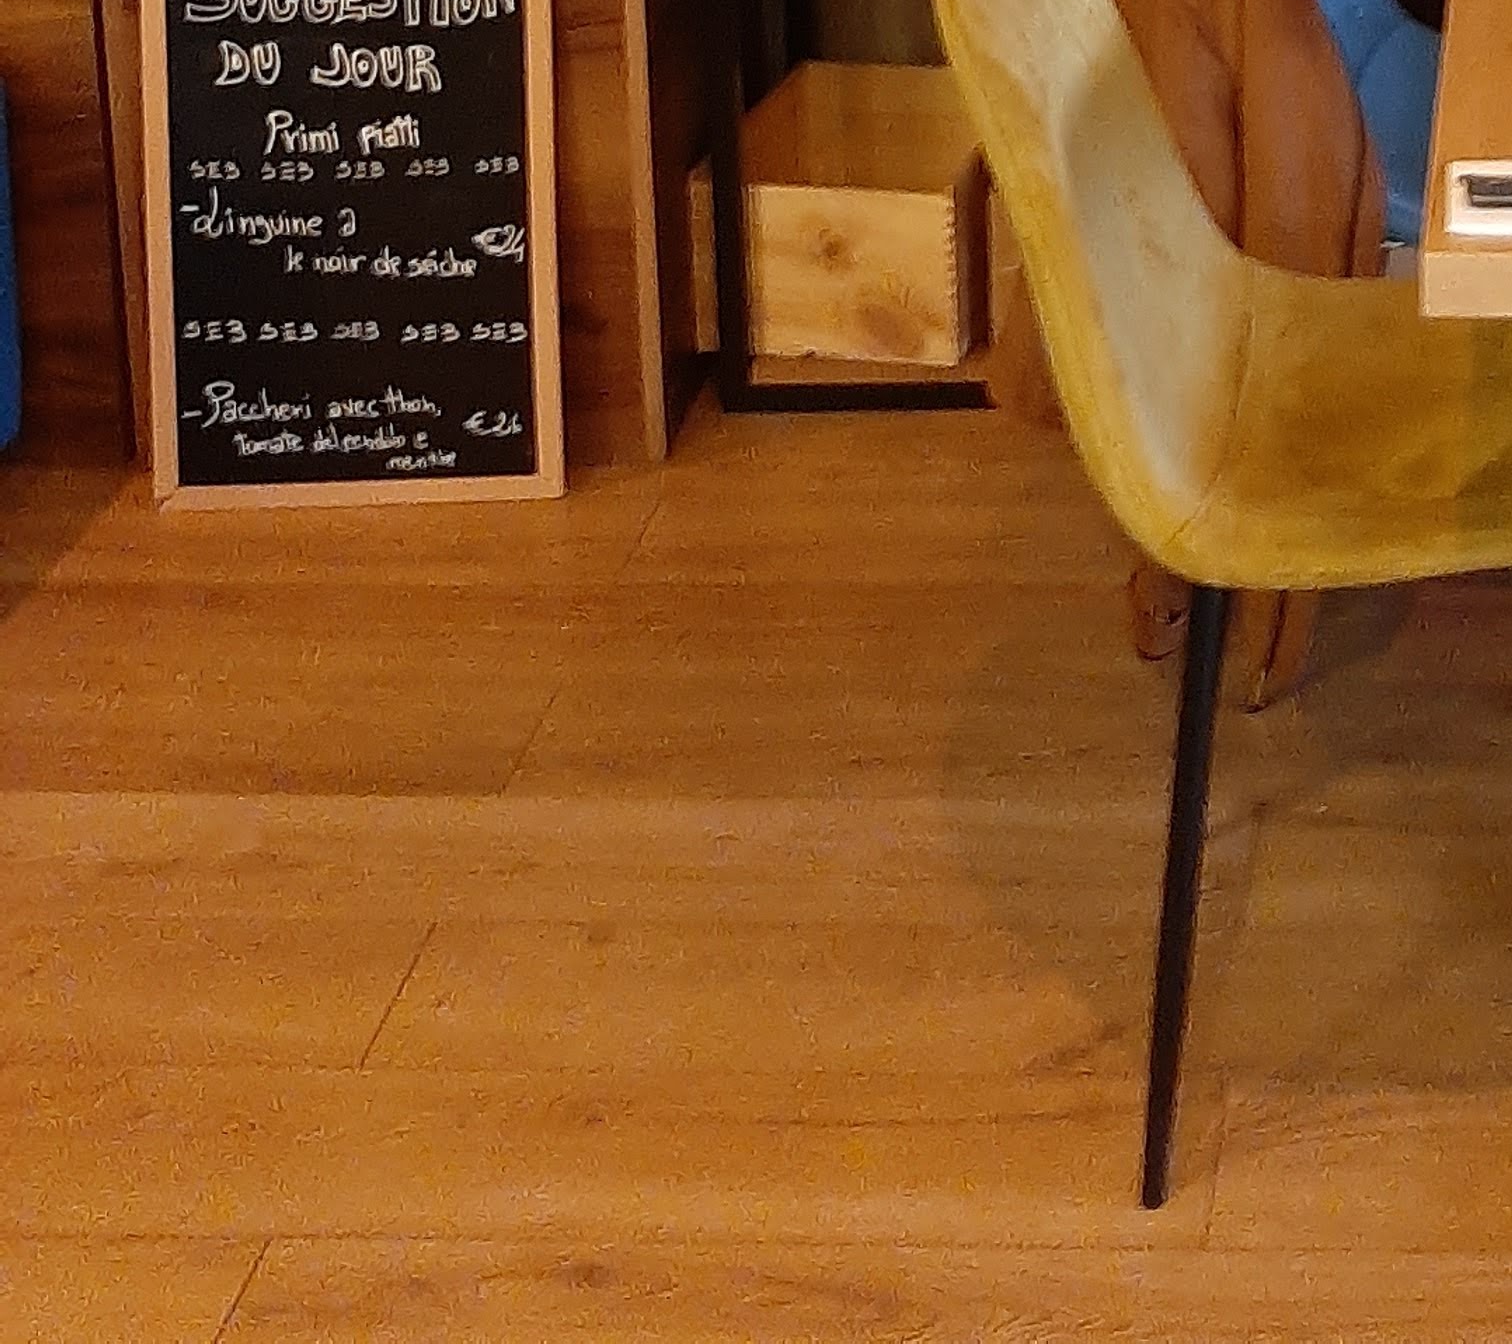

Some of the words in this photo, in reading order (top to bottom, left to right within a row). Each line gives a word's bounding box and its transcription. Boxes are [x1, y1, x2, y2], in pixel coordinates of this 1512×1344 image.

[215, 40, 281, 86] DU
[309, 42, 442, 93] JOUR
[262, 109, 341, 156] Primi
[312, 246, 366, 273] noir
[326, 398, 380, 419] avec
